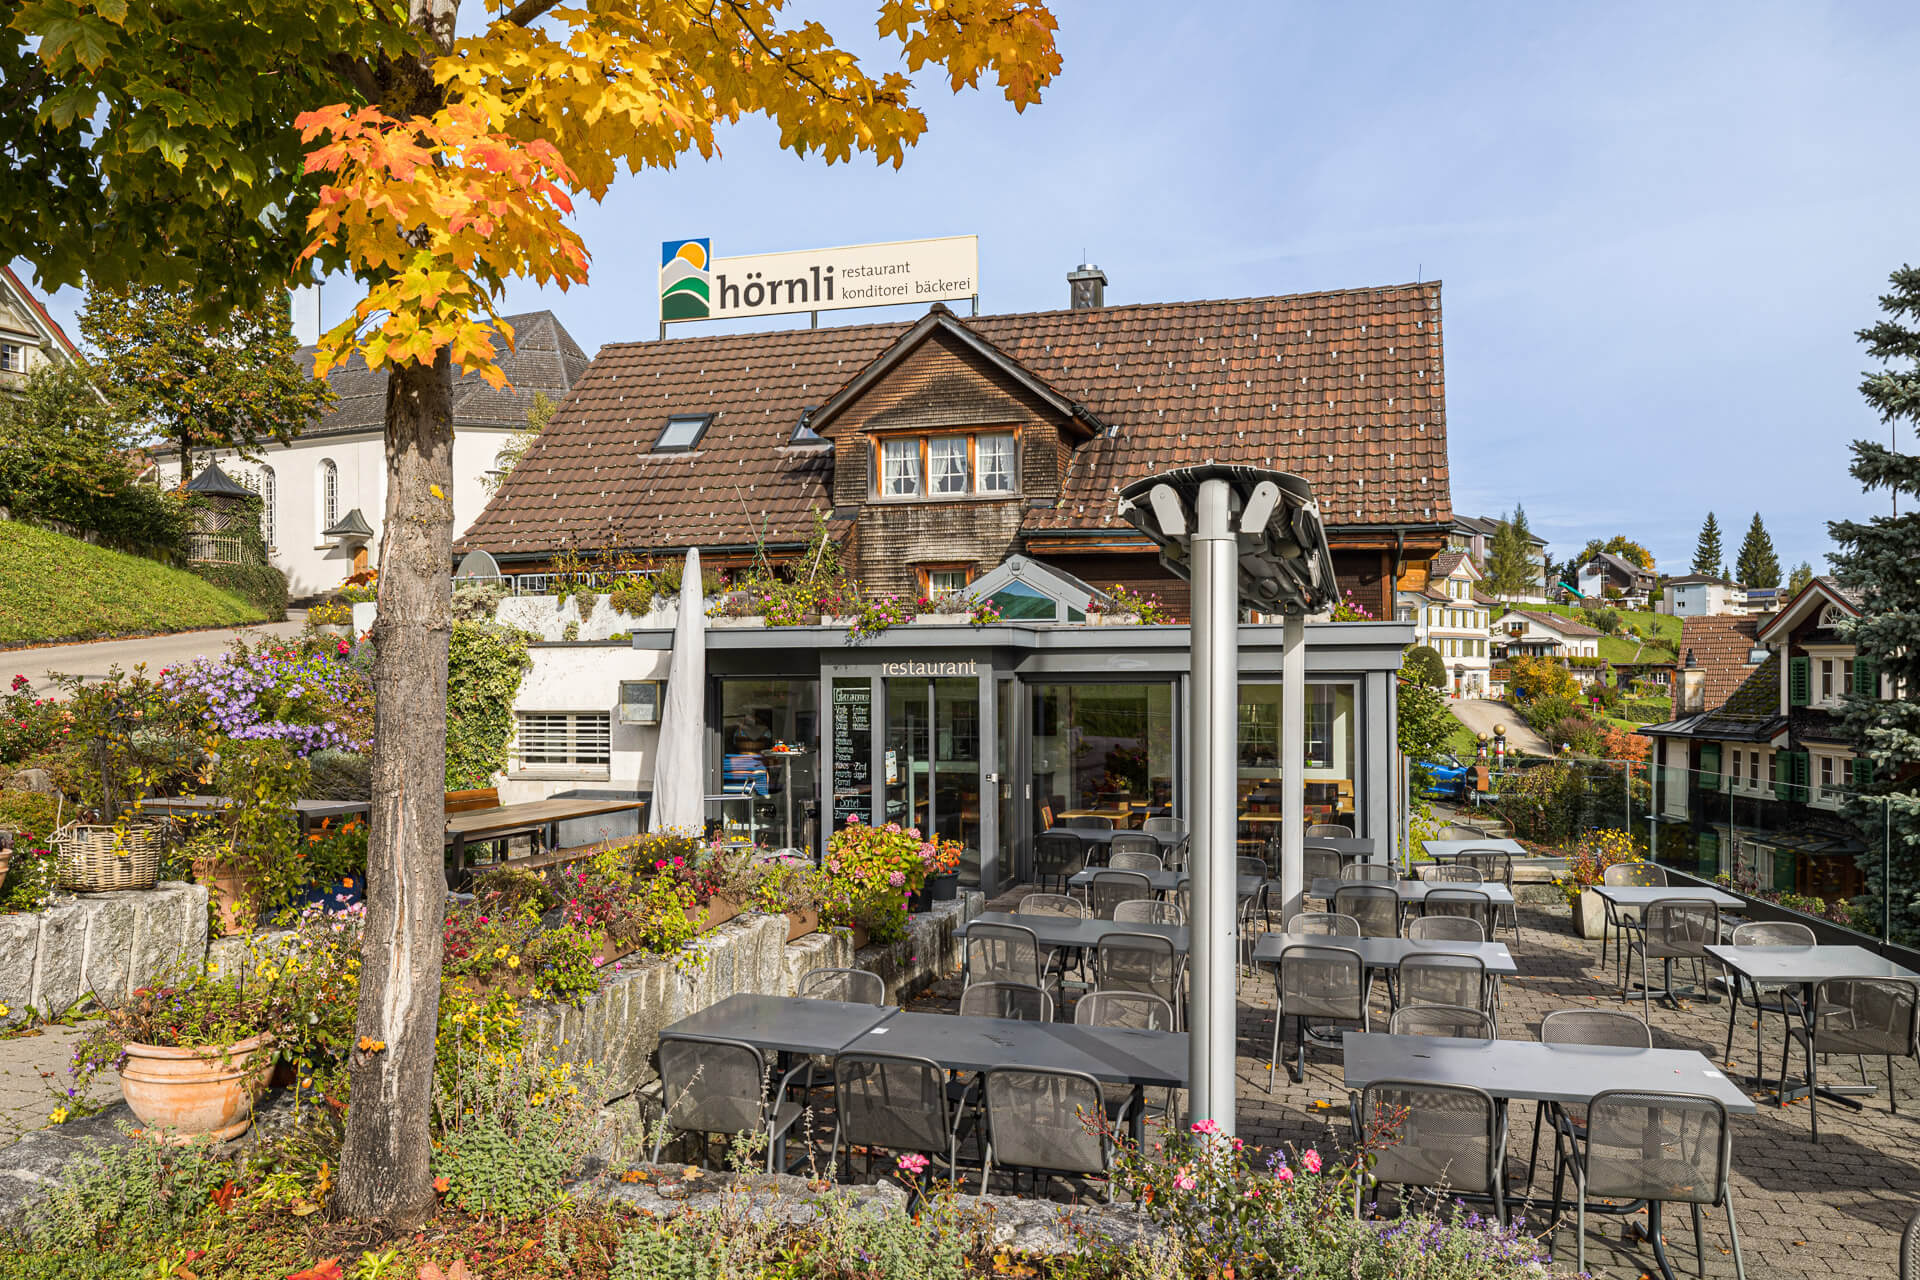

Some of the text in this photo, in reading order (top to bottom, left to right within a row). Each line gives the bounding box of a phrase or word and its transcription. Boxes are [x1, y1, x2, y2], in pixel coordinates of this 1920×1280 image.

[842, 261, 911, 278] restaurant
[716, 265, 834, 309] hörnli
[842, 277, 971, 300] konditorei bäckerei
[882, 658, 977, 675] restaurant
